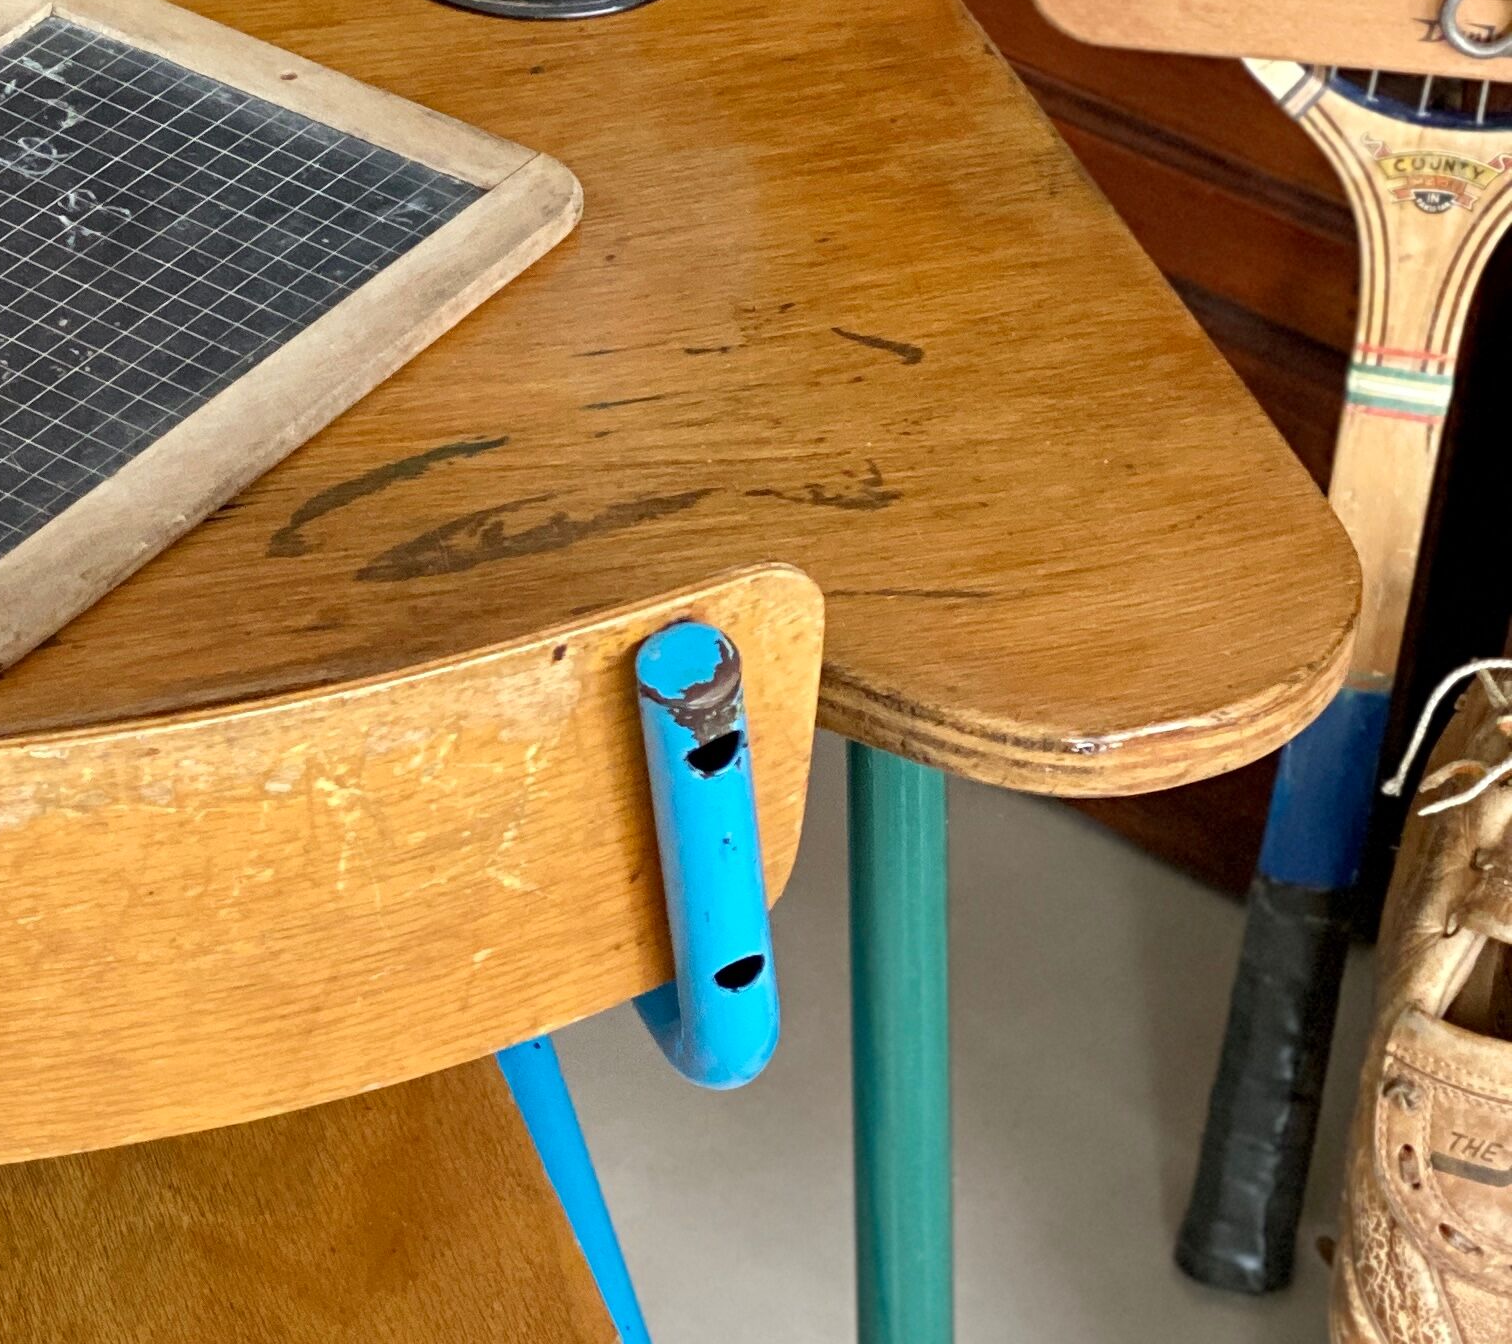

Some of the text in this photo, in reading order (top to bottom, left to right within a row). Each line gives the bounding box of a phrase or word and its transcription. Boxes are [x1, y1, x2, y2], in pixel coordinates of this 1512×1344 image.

[1393, 157, 1485, 180] COUNTY
[1427, 192, 1441, 203] IN
[1449, 1131, 1504, 1163] THE
